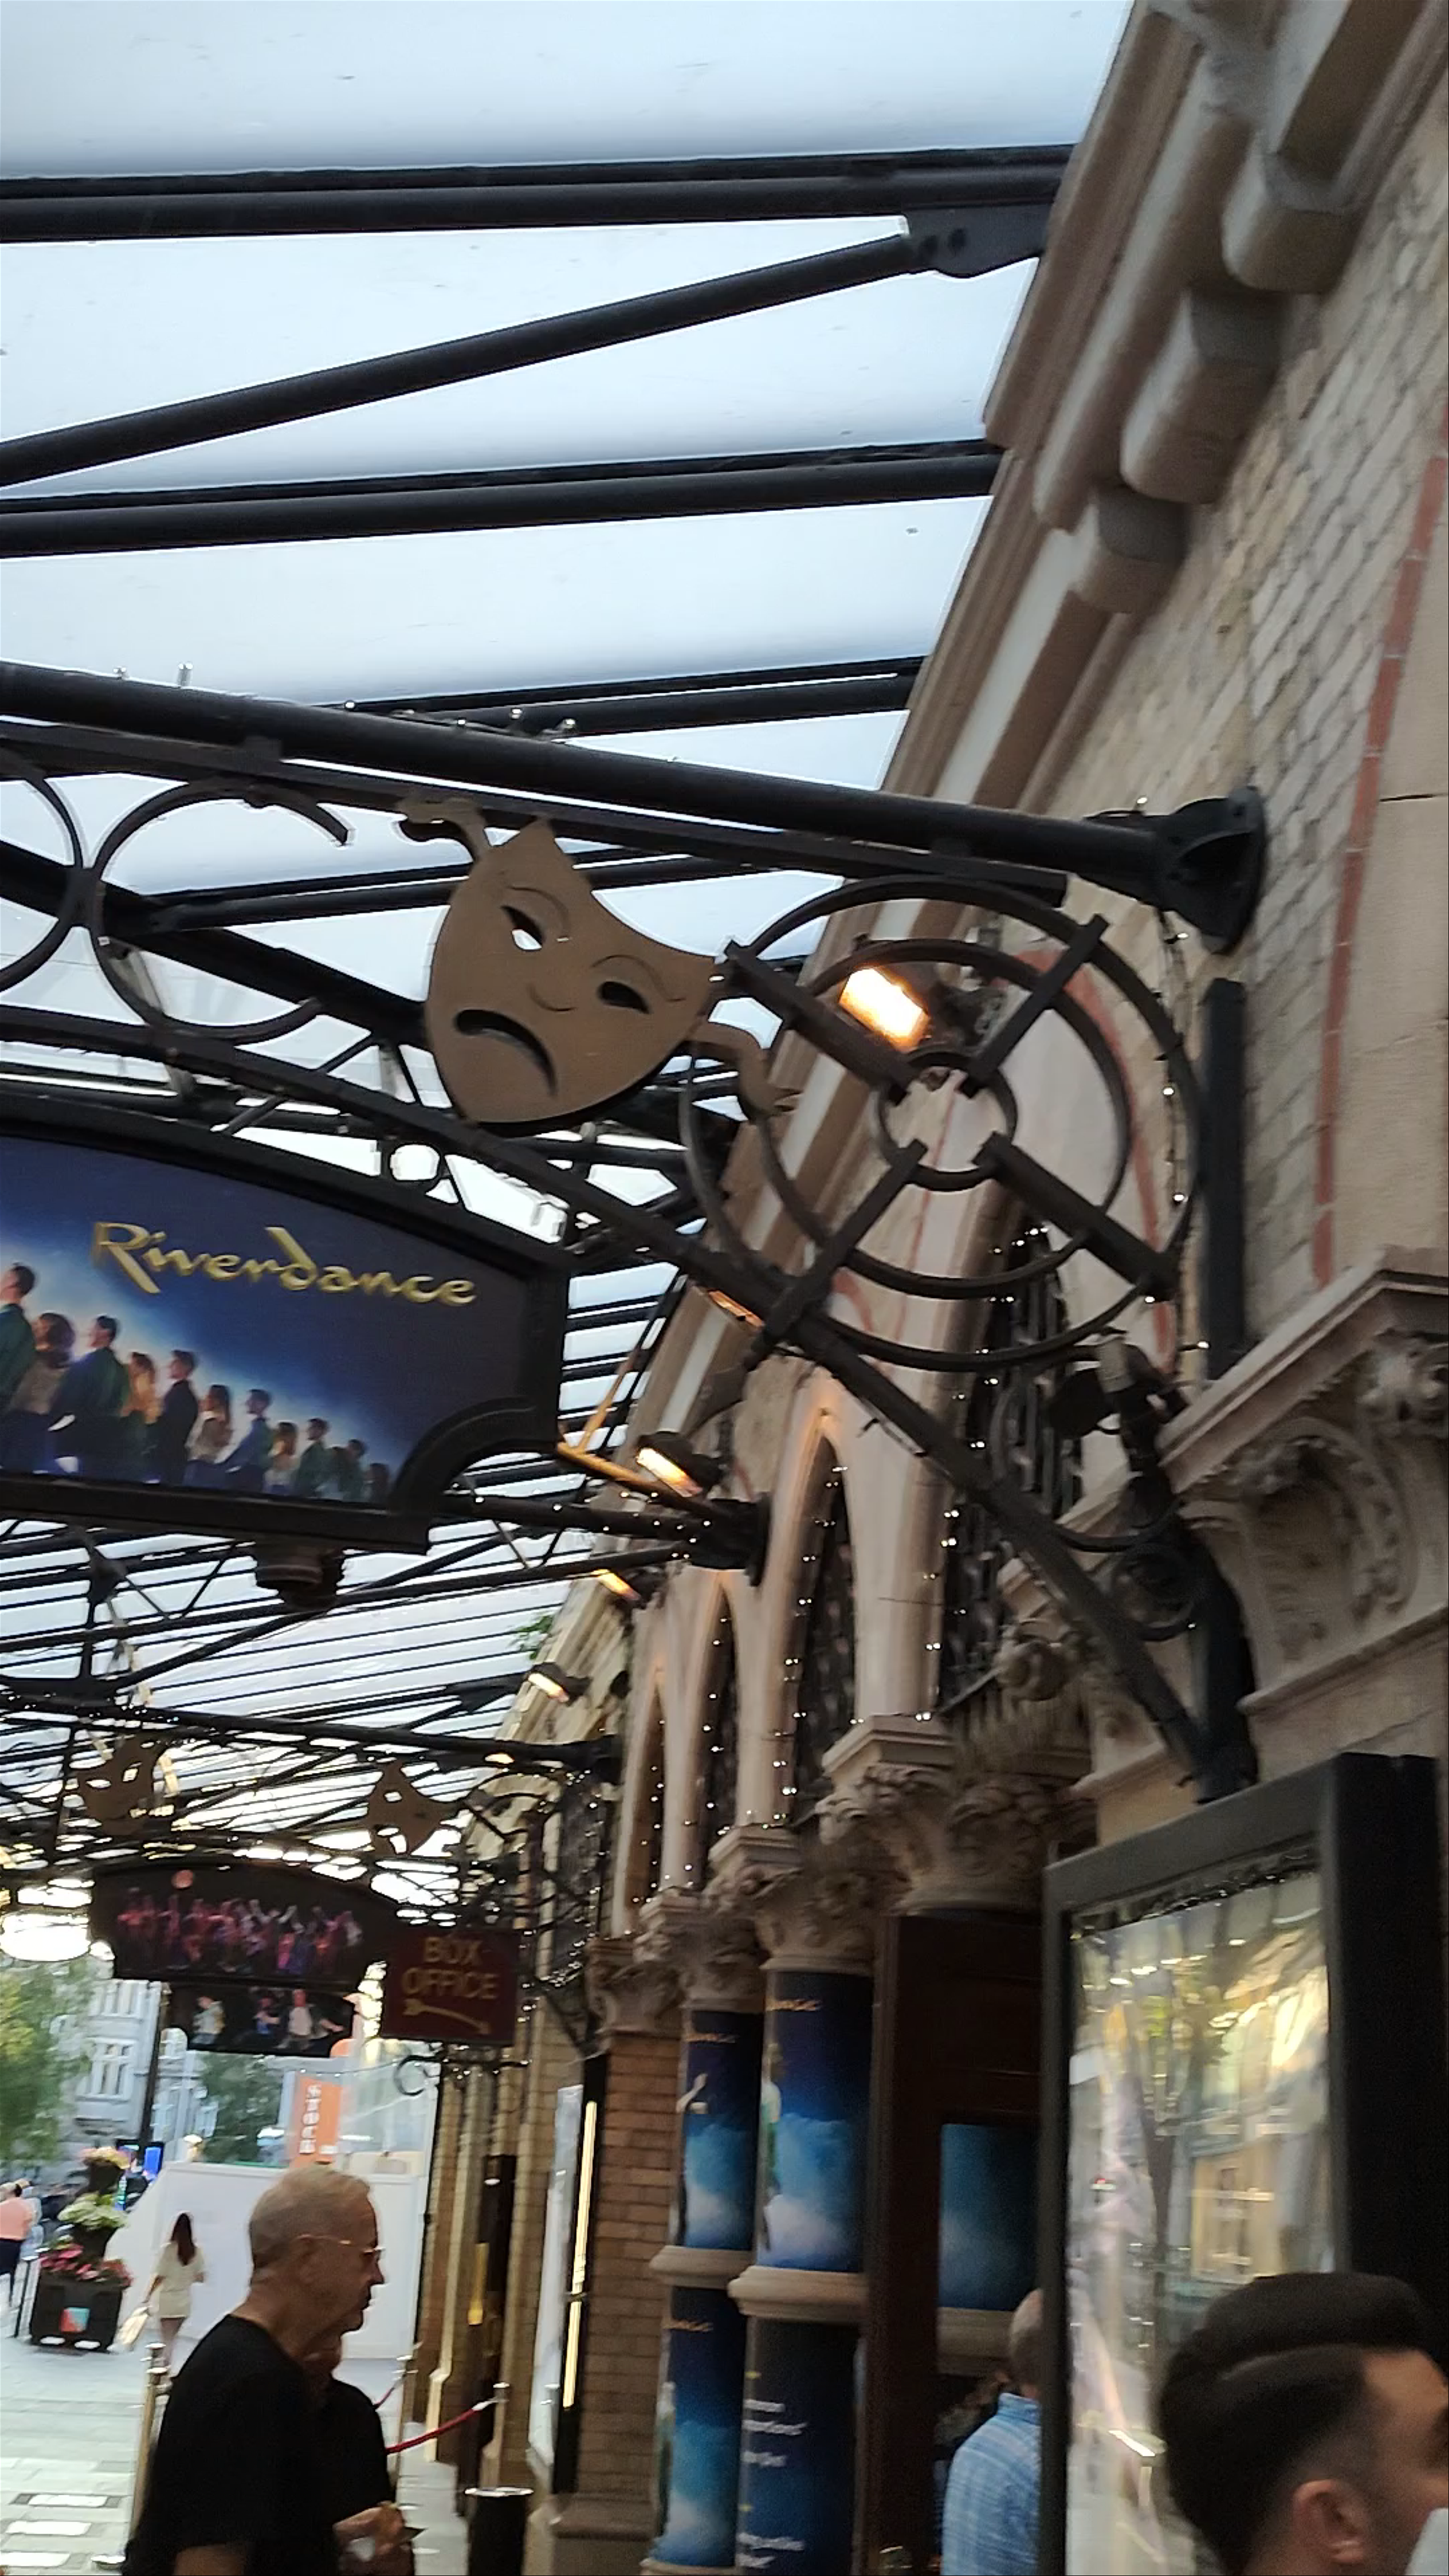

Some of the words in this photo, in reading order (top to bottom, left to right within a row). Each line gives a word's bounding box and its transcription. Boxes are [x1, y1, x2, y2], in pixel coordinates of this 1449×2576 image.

[93, 1221, 476, 1305] Riverdance
[424, 1936, 482, 1965] BOX
[401, 1967, 498, 1999] OFFICE
